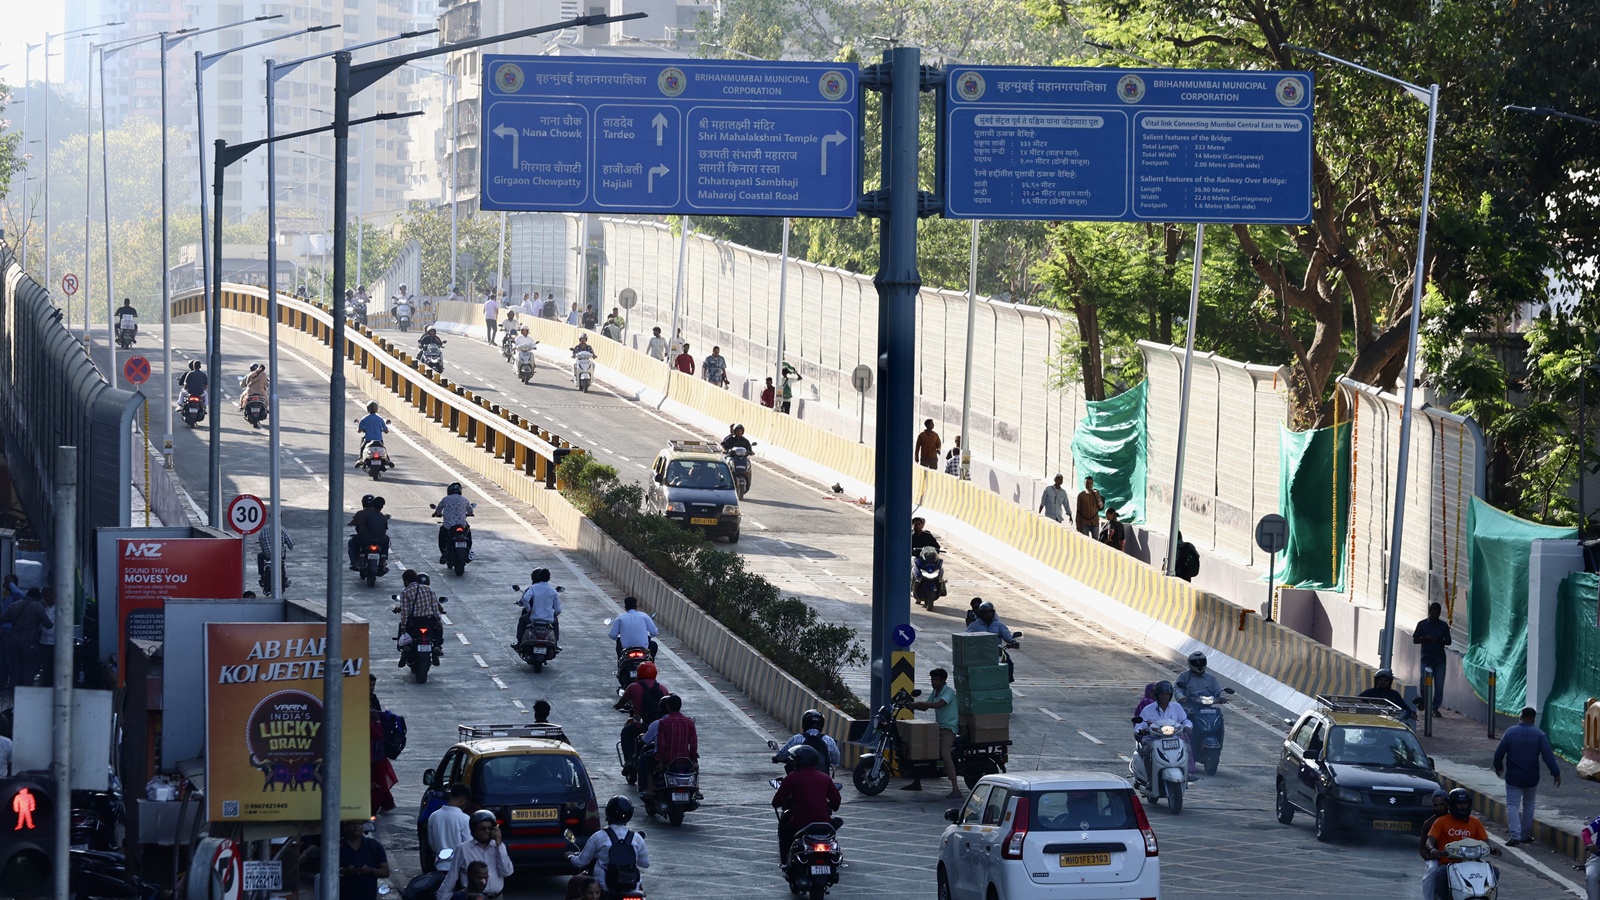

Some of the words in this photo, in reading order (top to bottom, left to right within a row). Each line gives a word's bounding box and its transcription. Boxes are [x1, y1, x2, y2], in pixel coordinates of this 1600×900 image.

[536, 72, 573, 86] बृहन्मुंबई
[576, 74, 646, 86] महानगरपालिका
[695, 74, 762, 83] BRIHANMUMBAI
[764, 75, 810, 84] MUNICIPAL
[723, 86, 782, 95] CORPORATION
[997, 80, 1034, 93] बृहन्मुंबई
[1037, 81, 1107, 93] महानगरपालिका
[1154, 81, 1220, 89] BRIHANMUMBAI
[1222, 82, 1267, 90] MUNICIPAL
[1181, 93, 1239, 101] CORPORATION
[540, 116, 560, 126] नाना
[563, 114, 582, 126] चौक
[603, 116, 634, 127] ताडदेव
[699, 118, 708, 129] श्री
[711, 119, 750, 130] महालक्ष्मी
[753, 120, 775, 130] मंदिर
[980, 116, 993, 125] मुंबई
[523, 129, 547, 137] Nana
[550, 129, 582, 138] Chowk
[603, 130, 635, 139] Tardeo
[698, 132, 716, 140] Shri
[720, 133, 781, 142] Mahalakshmi
[784, 134, 818, 144] Temple
[1211, 135, 1232, 143] Bridge:
[699, 148, 729, 159] छत्रपती
[732, 149, 762, 160] संभाजी
[765, 152, 797, 160] महाराज
[521, 161, 551, 172] गिरगाव
[554, 161, 581, 173] चौपाटी
[602, 163, 642, 174] हाजीअली
[699, 162, 724, 173] सागरी
[727, 162, 757, 173] किनारा
[760, 165, 780, 174] रस्ता
[494, 176, 530, 186] Girgaon
[532, 177, 581, 188] Chowpatty
[602, 180, 632, 190] Hajiali
[698, 177, 752, 187] Chhatrapati
[755, 177, 798, 188] Sambhaji
[698, 191, 736, 201] Maharaj
[739, 191, 772, 200] Coastal
[775, 192, 798, 200] Road
[236, 506, 258, 523] 30
[125, 575, 162, 583] MOVES
[165, 575, 187, 583] YOU
[246, 640, 281, 660] AB
[218, 664, 260, 684] KOI
[261, 658, 362, 682] JEETEA!
[259, 721, 321, 738] LUCKY
[270, 738, 312, 750] DRAW
[1448, 828, 1470, 836] Calvin
[1066, 855, 1108, 864] MH01FE3163
